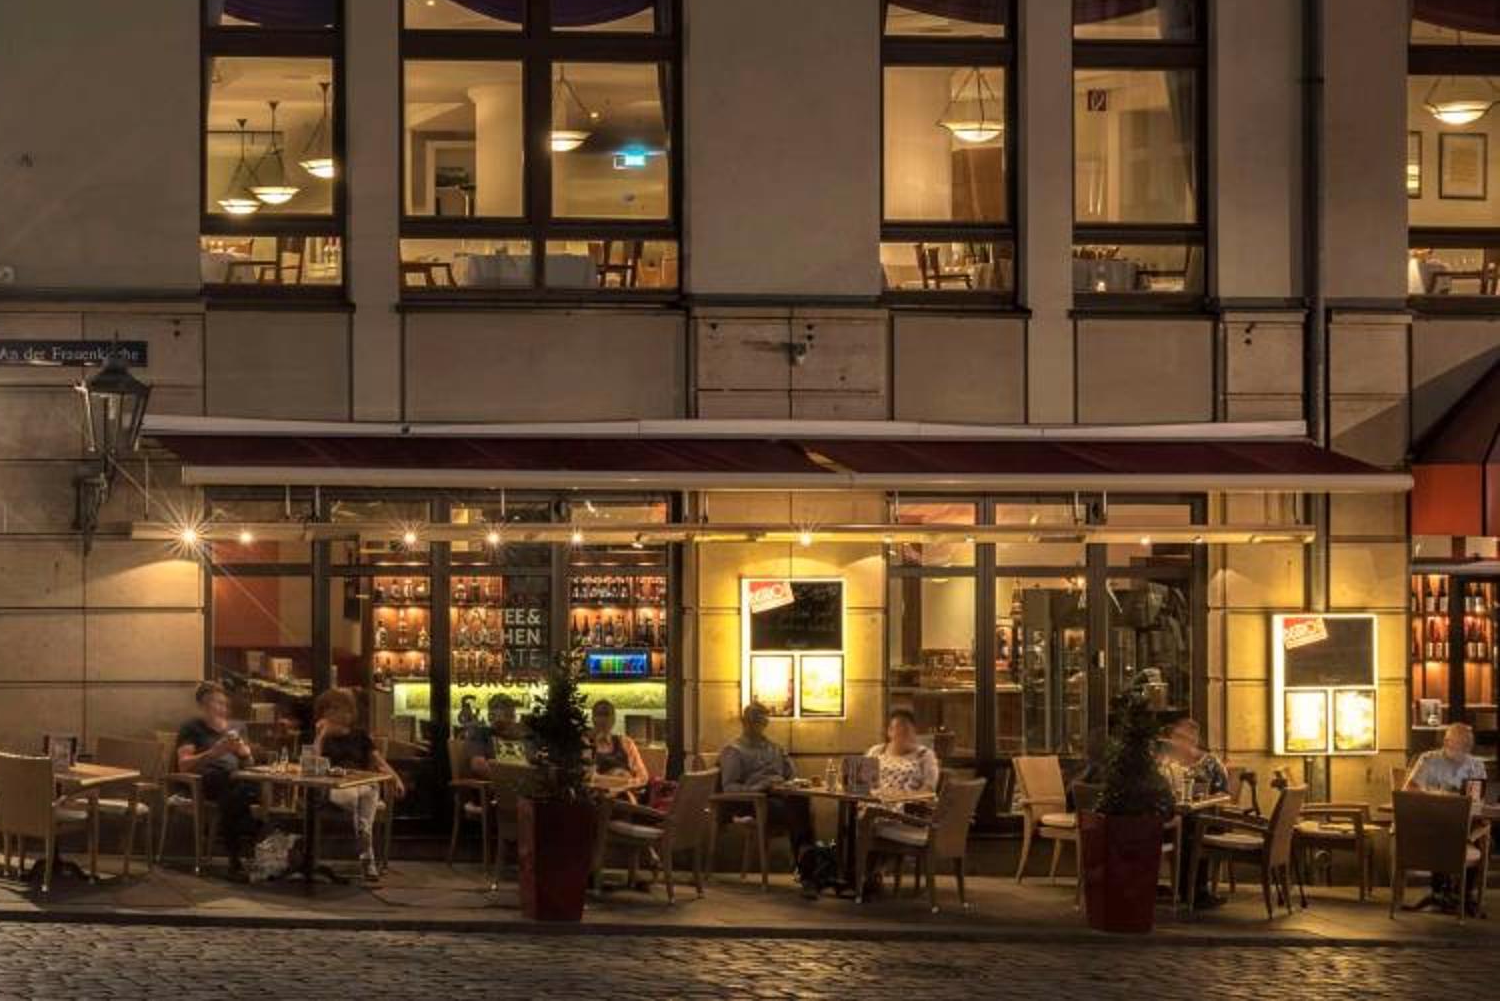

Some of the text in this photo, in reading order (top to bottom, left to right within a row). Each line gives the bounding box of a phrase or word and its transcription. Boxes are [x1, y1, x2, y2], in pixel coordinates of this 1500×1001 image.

[0, 346, 140, 361] An der Frauenkhe
